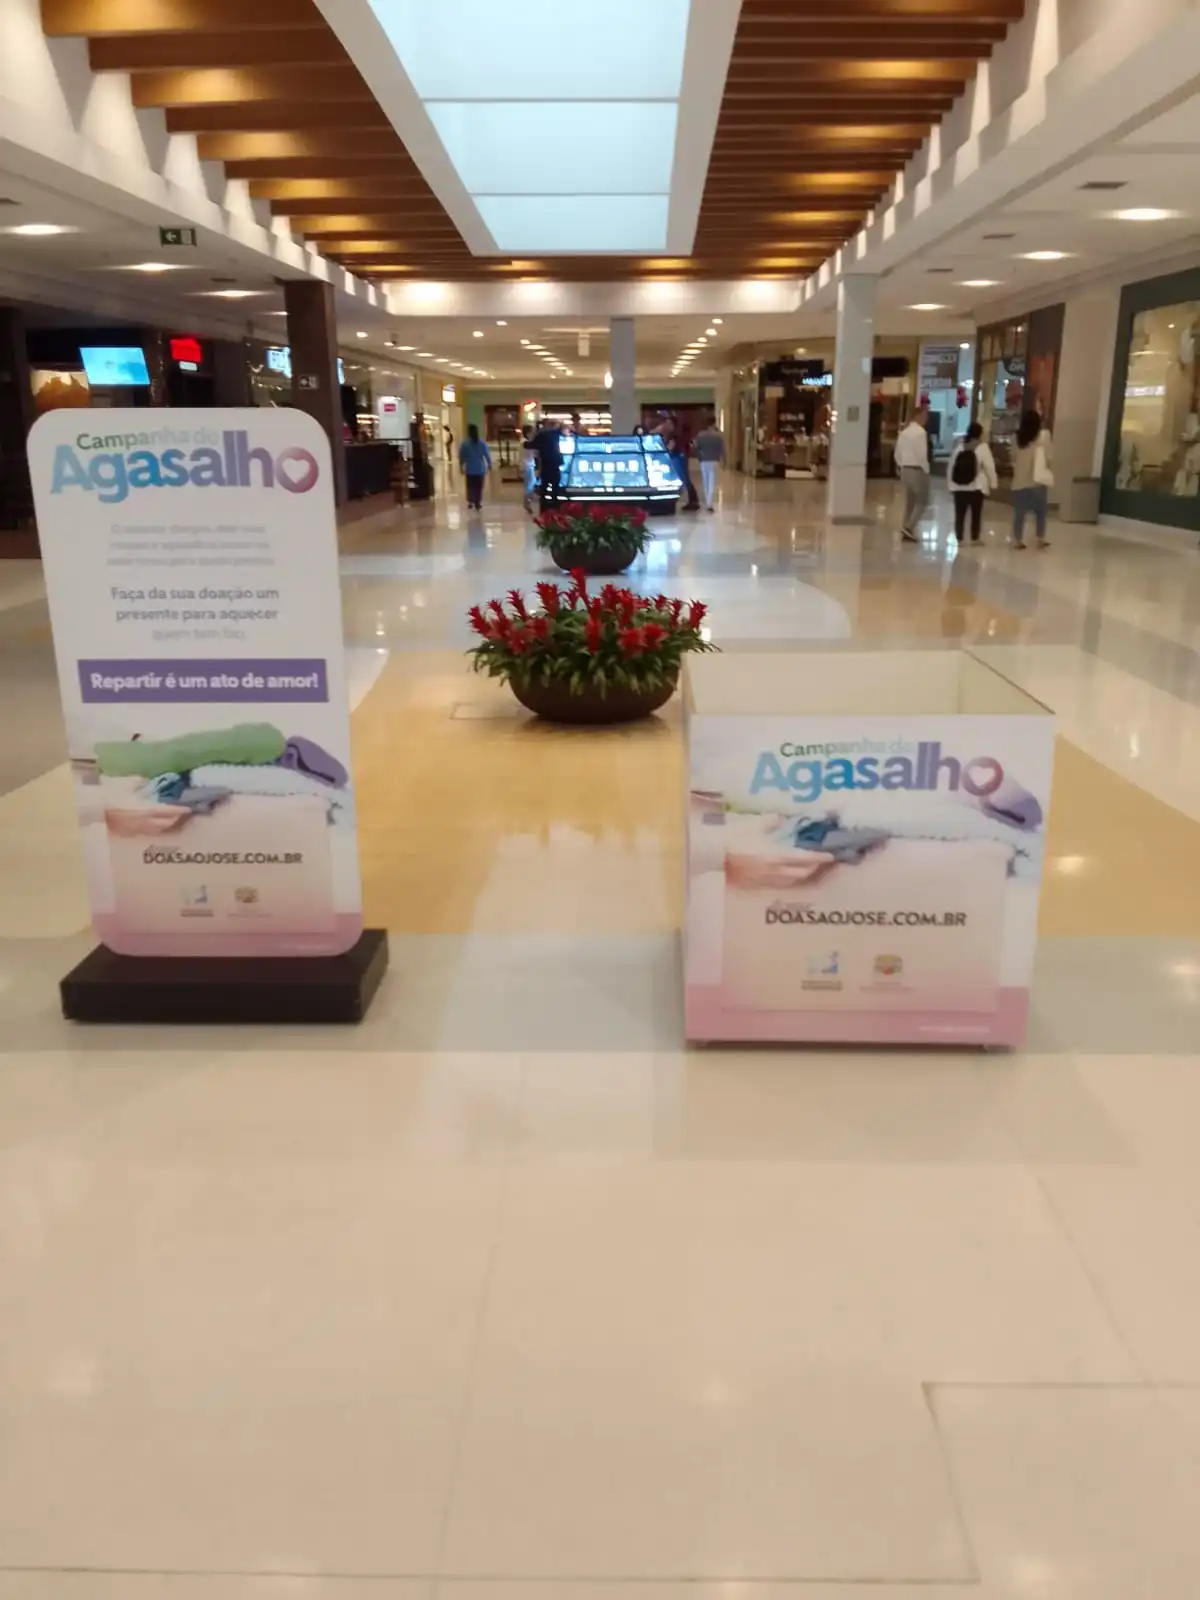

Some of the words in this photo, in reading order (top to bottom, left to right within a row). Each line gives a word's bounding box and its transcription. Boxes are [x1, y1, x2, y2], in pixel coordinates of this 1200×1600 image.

[77, 426, 188, 450] Campanha
[50, 430, 319, 503] Agasalho
[110, 586, 145, 603] Faça
[148, 586, 167, 599] da
[169, 589, 196, 600] sua
[198, 585, 253, 603] doação
[256, 589, 280, 599] um
[116, 609, 179, 623] presente
[182, 610, 216, 624] para
[219, 610, 279, 623] aquecer
[91, 672, 162, 693] Repartir
[165, 673, 177, 688] é
[179, 676, 208, 688] um
[210, 674, 239, 688] ato
[242, 673, 265, 688] de
[267, 673, 319, 688] amor!
[780, 737, 886, 758] Campanha
[749, 741, 1004, 802] Agasalho
[144, 852, 302, 864] DOASAOJOSE.COM.BR
[765, 910, 967, 925] DOASAOJOSE.COM.BR
